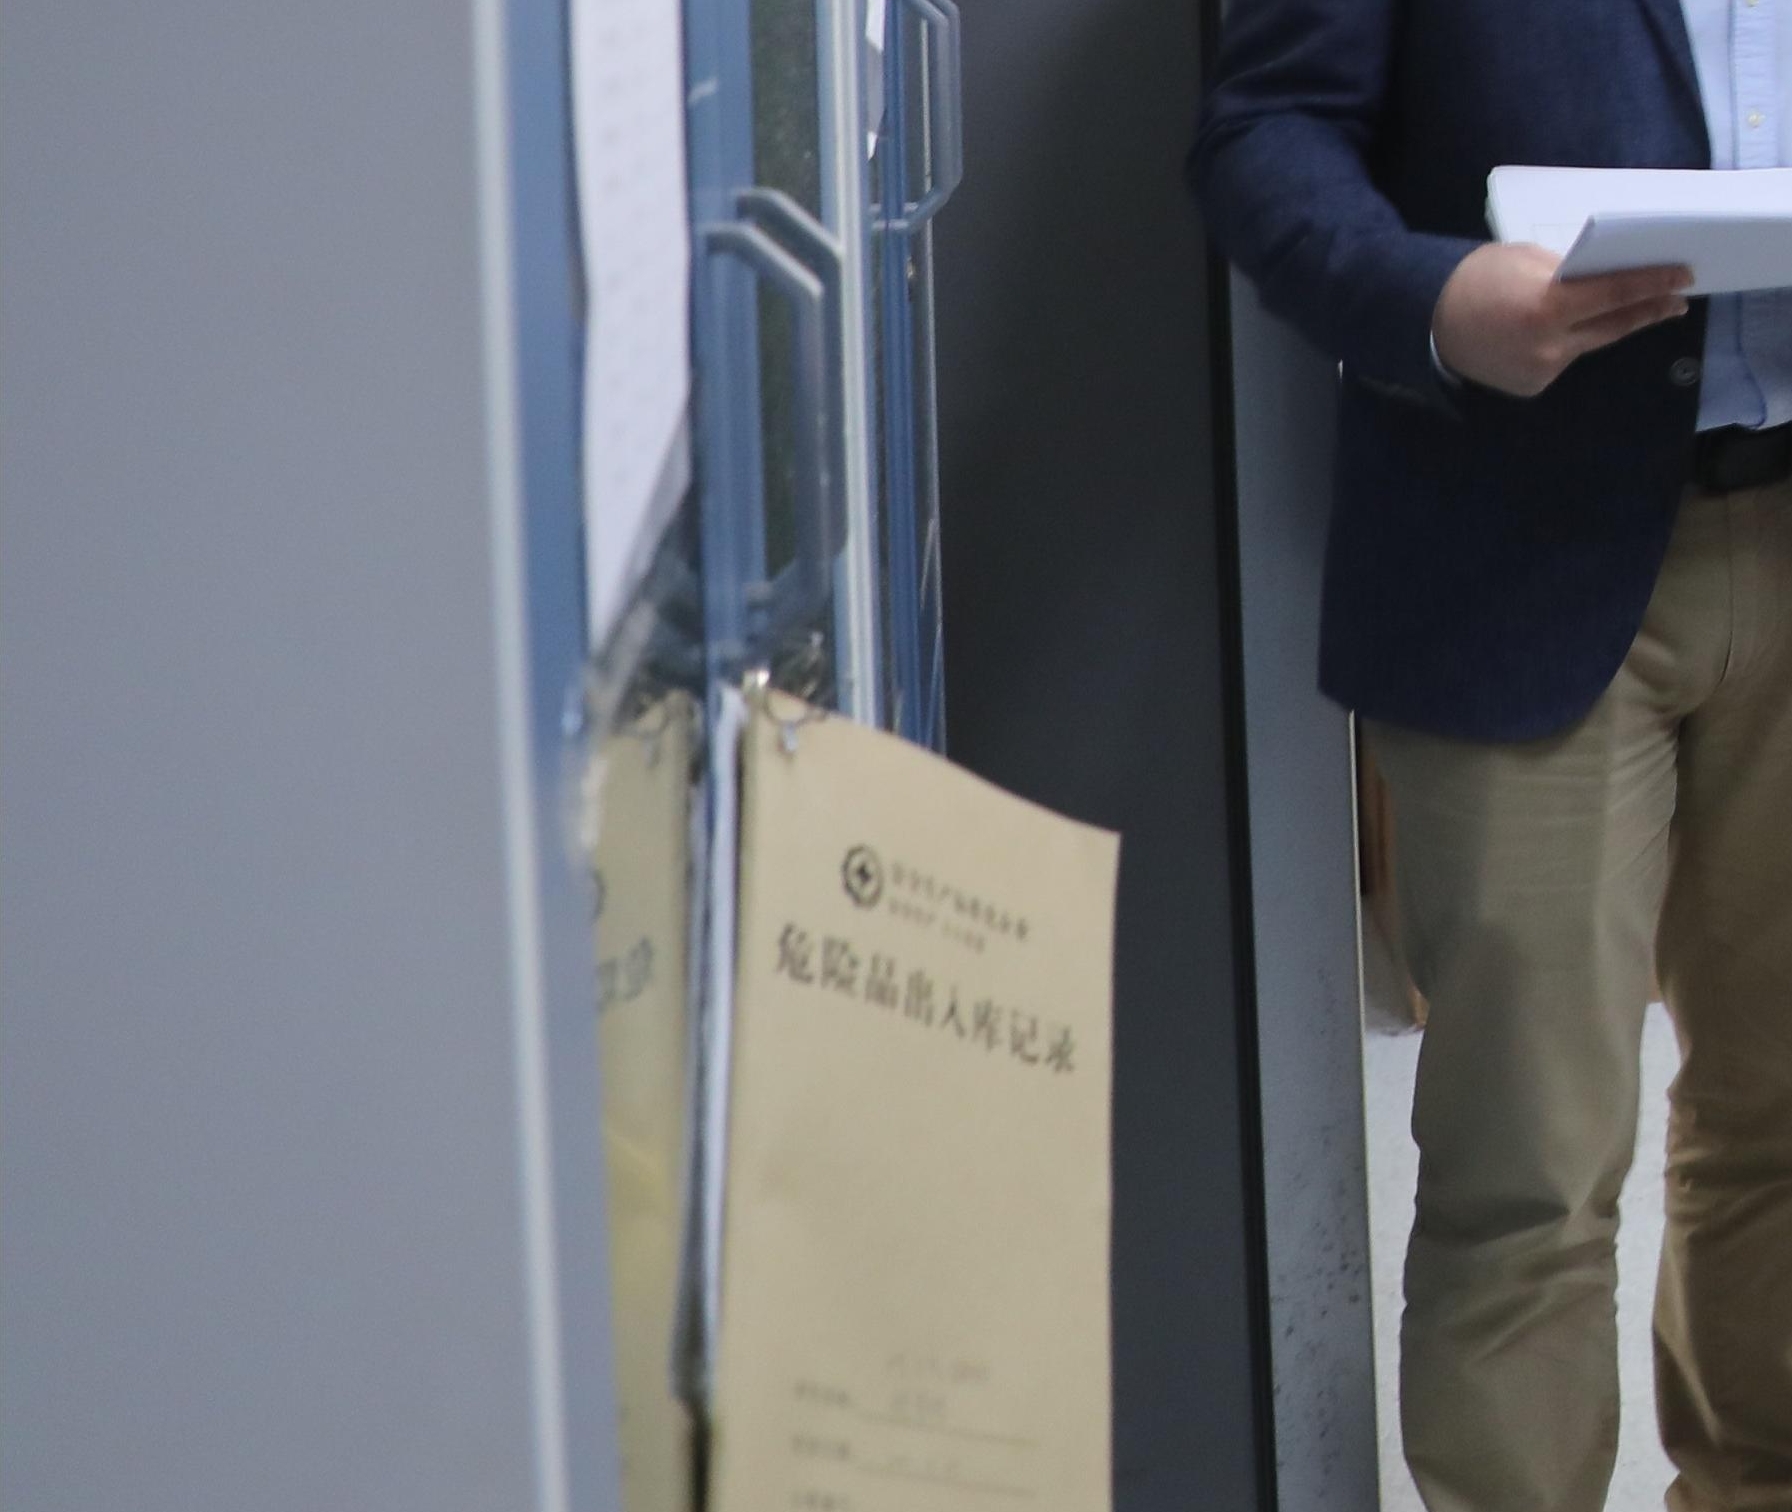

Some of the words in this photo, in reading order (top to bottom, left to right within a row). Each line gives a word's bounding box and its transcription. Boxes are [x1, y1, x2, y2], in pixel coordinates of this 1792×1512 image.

[777, 920, 1076, 1073] 危险品出入库记录
